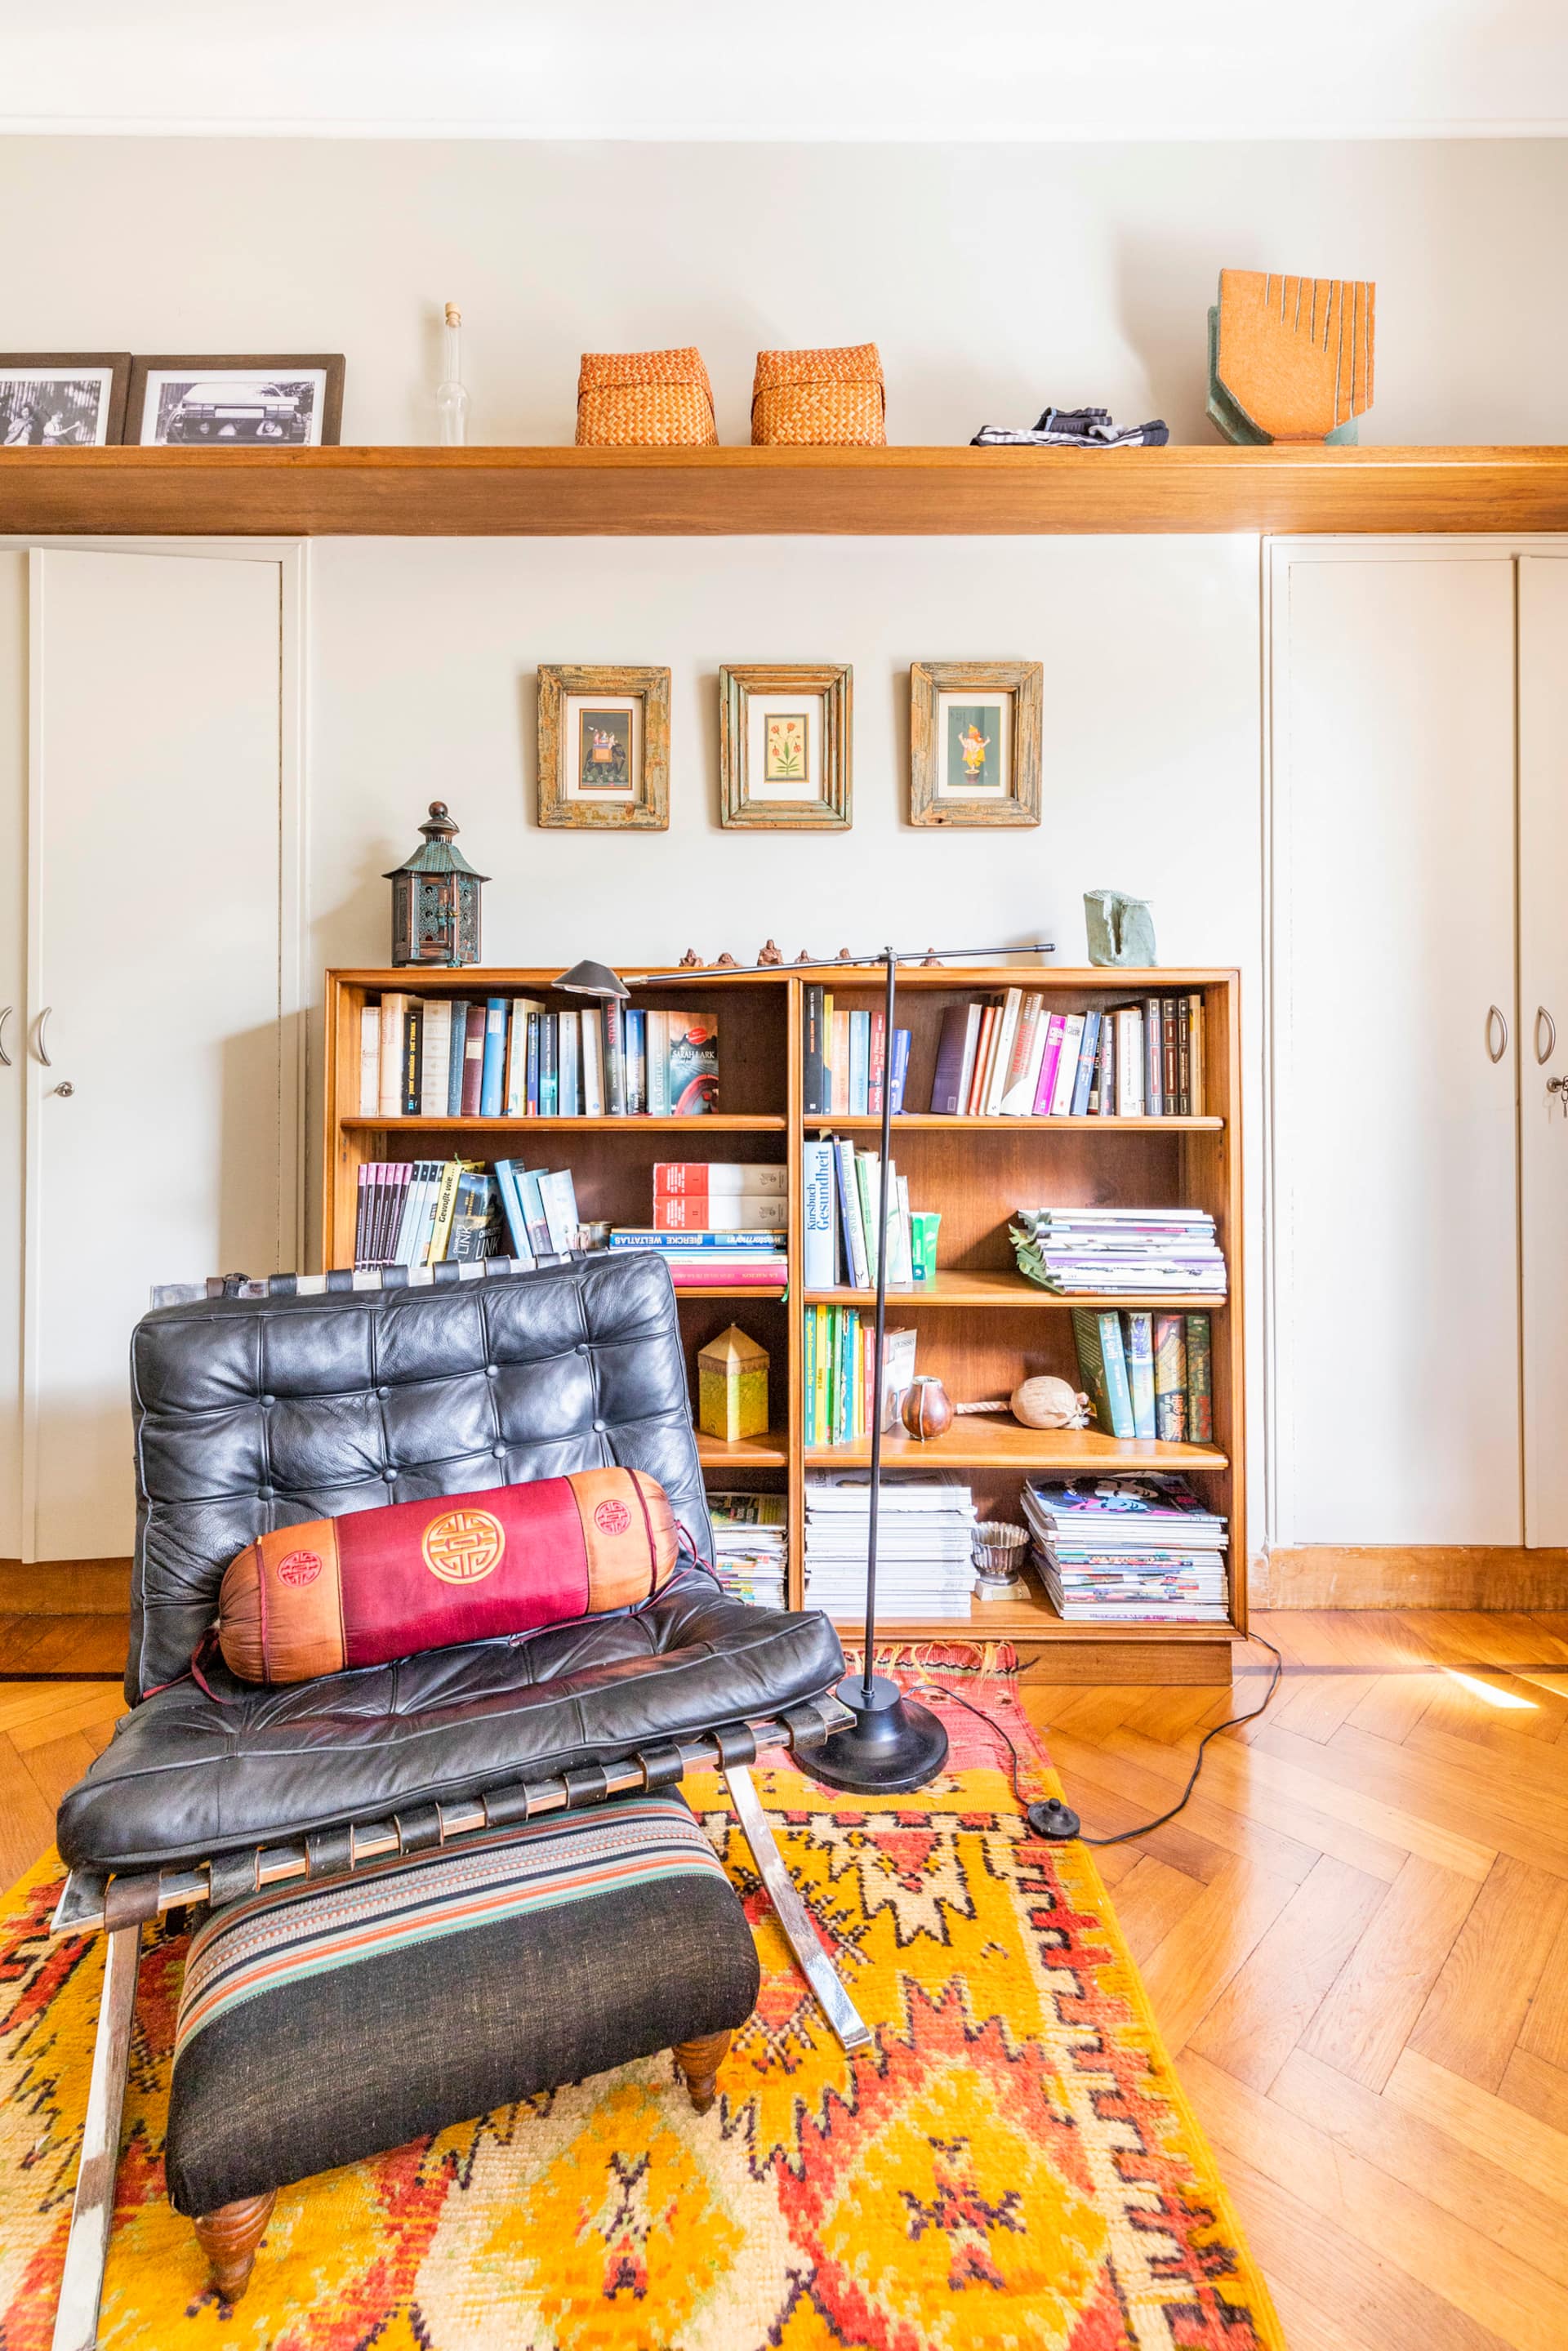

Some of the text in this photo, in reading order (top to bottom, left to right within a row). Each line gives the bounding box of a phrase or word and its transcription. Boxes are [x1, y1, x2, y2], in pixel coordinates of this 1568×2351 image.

[607, 1003, 617, 1044] STONER
[672, 1050, 715, 1059] SARAH LARK
[807, 1182, 816, 1231] Kursbuch
[815, 1149, 830, 1231] Gesundheit
[457, 1224, 472, 1255] LINK
[614, 1235, 703, 1246] DIERCKE WELTATLAS
